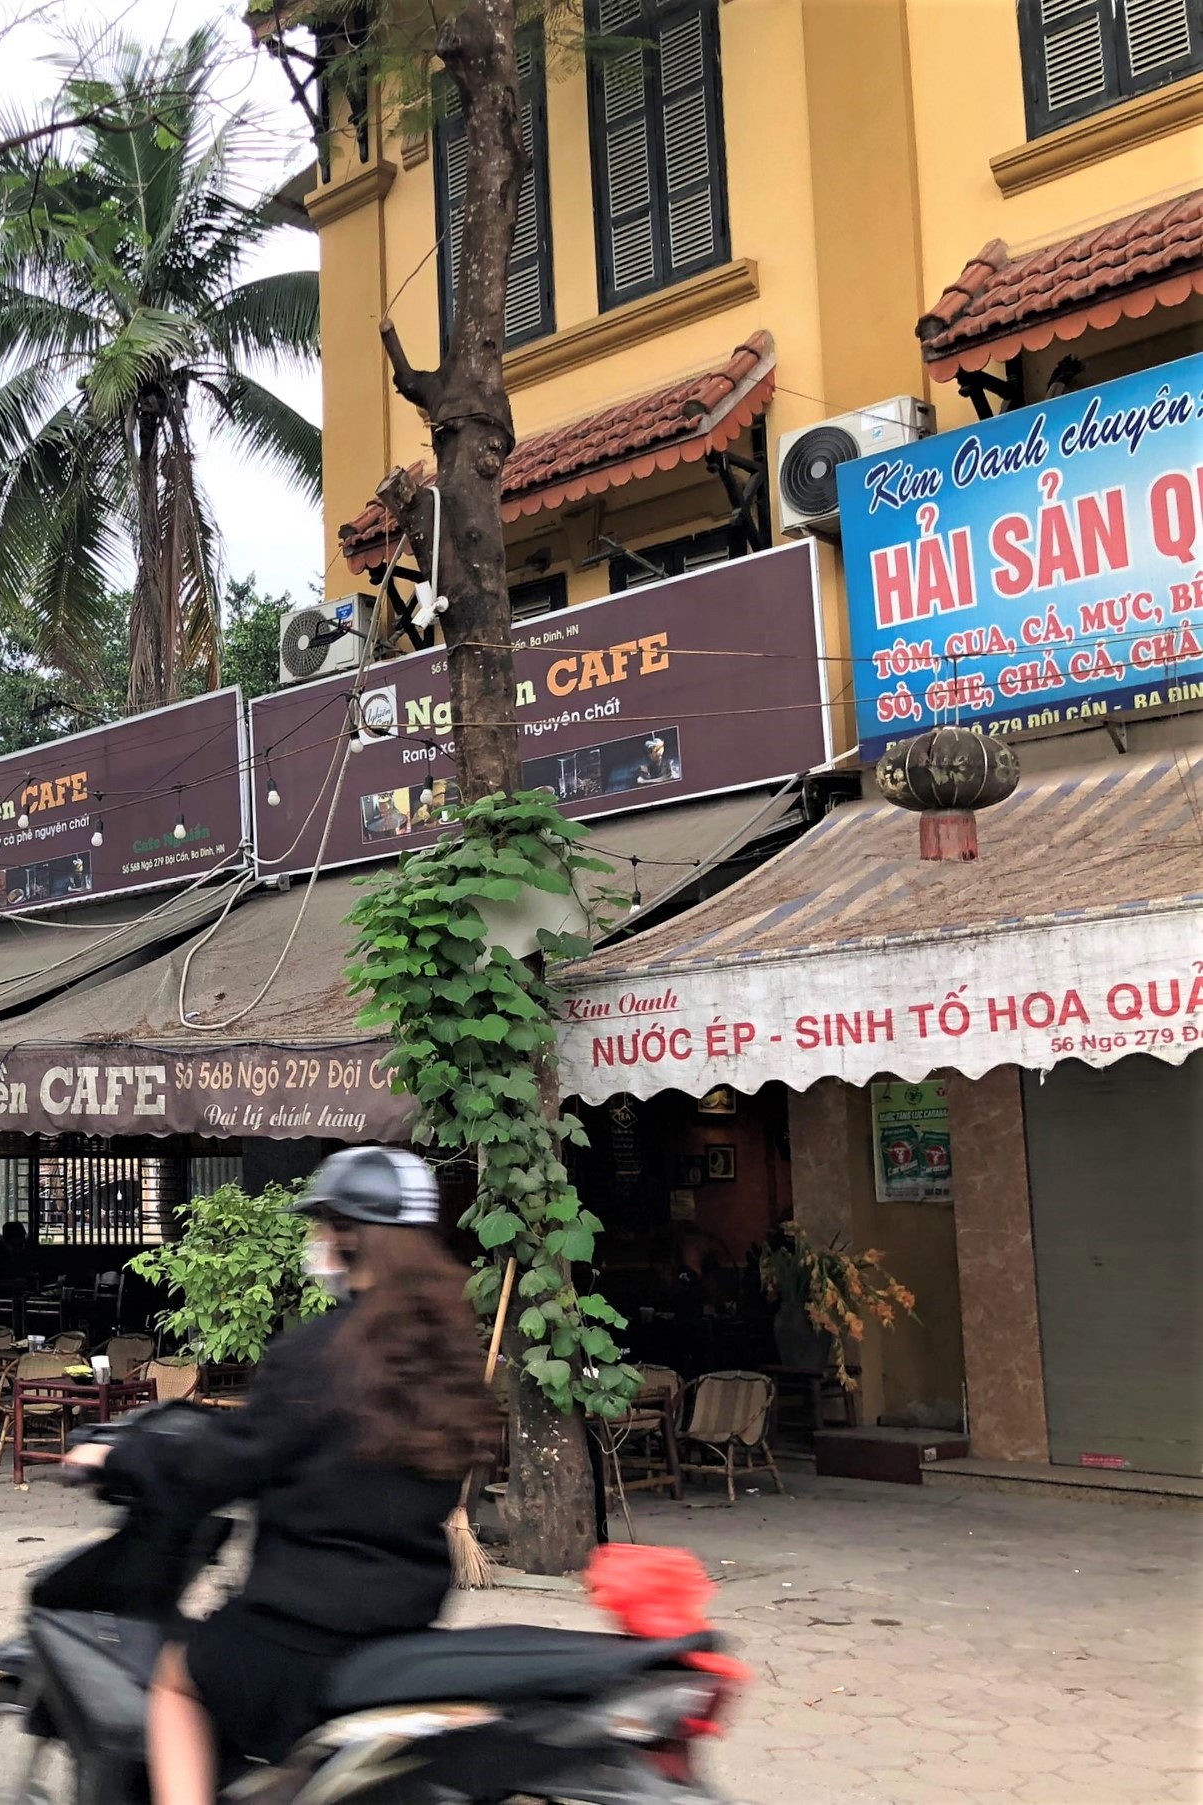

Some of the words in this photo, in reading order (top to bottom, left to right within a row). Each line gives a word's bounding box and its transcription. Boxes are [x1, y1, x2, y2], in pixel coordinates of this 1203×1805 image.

[866, 460, 942, 513] Kim
[953, 415, 1047, 487] Oanh
[872, 505, 975, 628] HẢI
[991, 471, 1128, 597] SẢN
[1151, 466, 1203, 564] Q
[530, 636, 541, 647] Ba
[543, 629, 564, 642] Đình,
[566, 624, 579, 637] HN
[946, 627, 1016, 661] CUA,
[1022, 605, 1073, 645] CÁ,
[1080, 592, 1162, 635] MỰC,
[431, 662, 442, 674] Số
[546, 632, 669, 696] CAFE
[877, 682, 922, 721] SÒ,
[999, 649, 1065, 698] CHẢ
[1070, 641, 1125, 681] CÁ,
[1131, 620, 1203, 669] CHẢ
[403, 746, 436, 763] Rang
[440, 741, 456, 755] xa
[524, 711, 580, 736] nguyên
[585, 697, 620, 720] chất
[21, 771, 88, 814] CAFE
[3, 833, 15, 845] cà
[16, 829, 33, 846] phê
[34, 822, 67, 840] nguyên
[69, 812, 90, 830] chất
[215, 843, 225, 854] HN
[562, 999, 611, 1020] Kim
[618, 988, 679, 1014] Oanh
[593, 1022, 693, 1067] NƯỚC
[706, 1016, 755, 1057] ÉP
[796, 1009, 895, 1049] SINH
[909, 985, 971, 1038] TỐ
[989, 989, 1090, 1032] HOA
[1051, 1037, 1074, 1053] 56
[1082, 1032, 1126, 1053] Ngõ
[1135, 1028, 1174, 1046] 279
[1182, 1026, 1203, 1042] Đ
[40, 1066, 167, 1117] CAFE
[198, 1062, 233, 1090] 56B
[237, 1060, 280, 1096] Ngõ
[285, 1059, 320, 1089] 279
[328, 1060, 361, 1095] Đội
[204, 1103, 238, 1130] Đại
[242, 1104, 264, 1131] lý
[269, 1103, 312, 1128] chính
[317, 1106, 367, 1133] hãng
